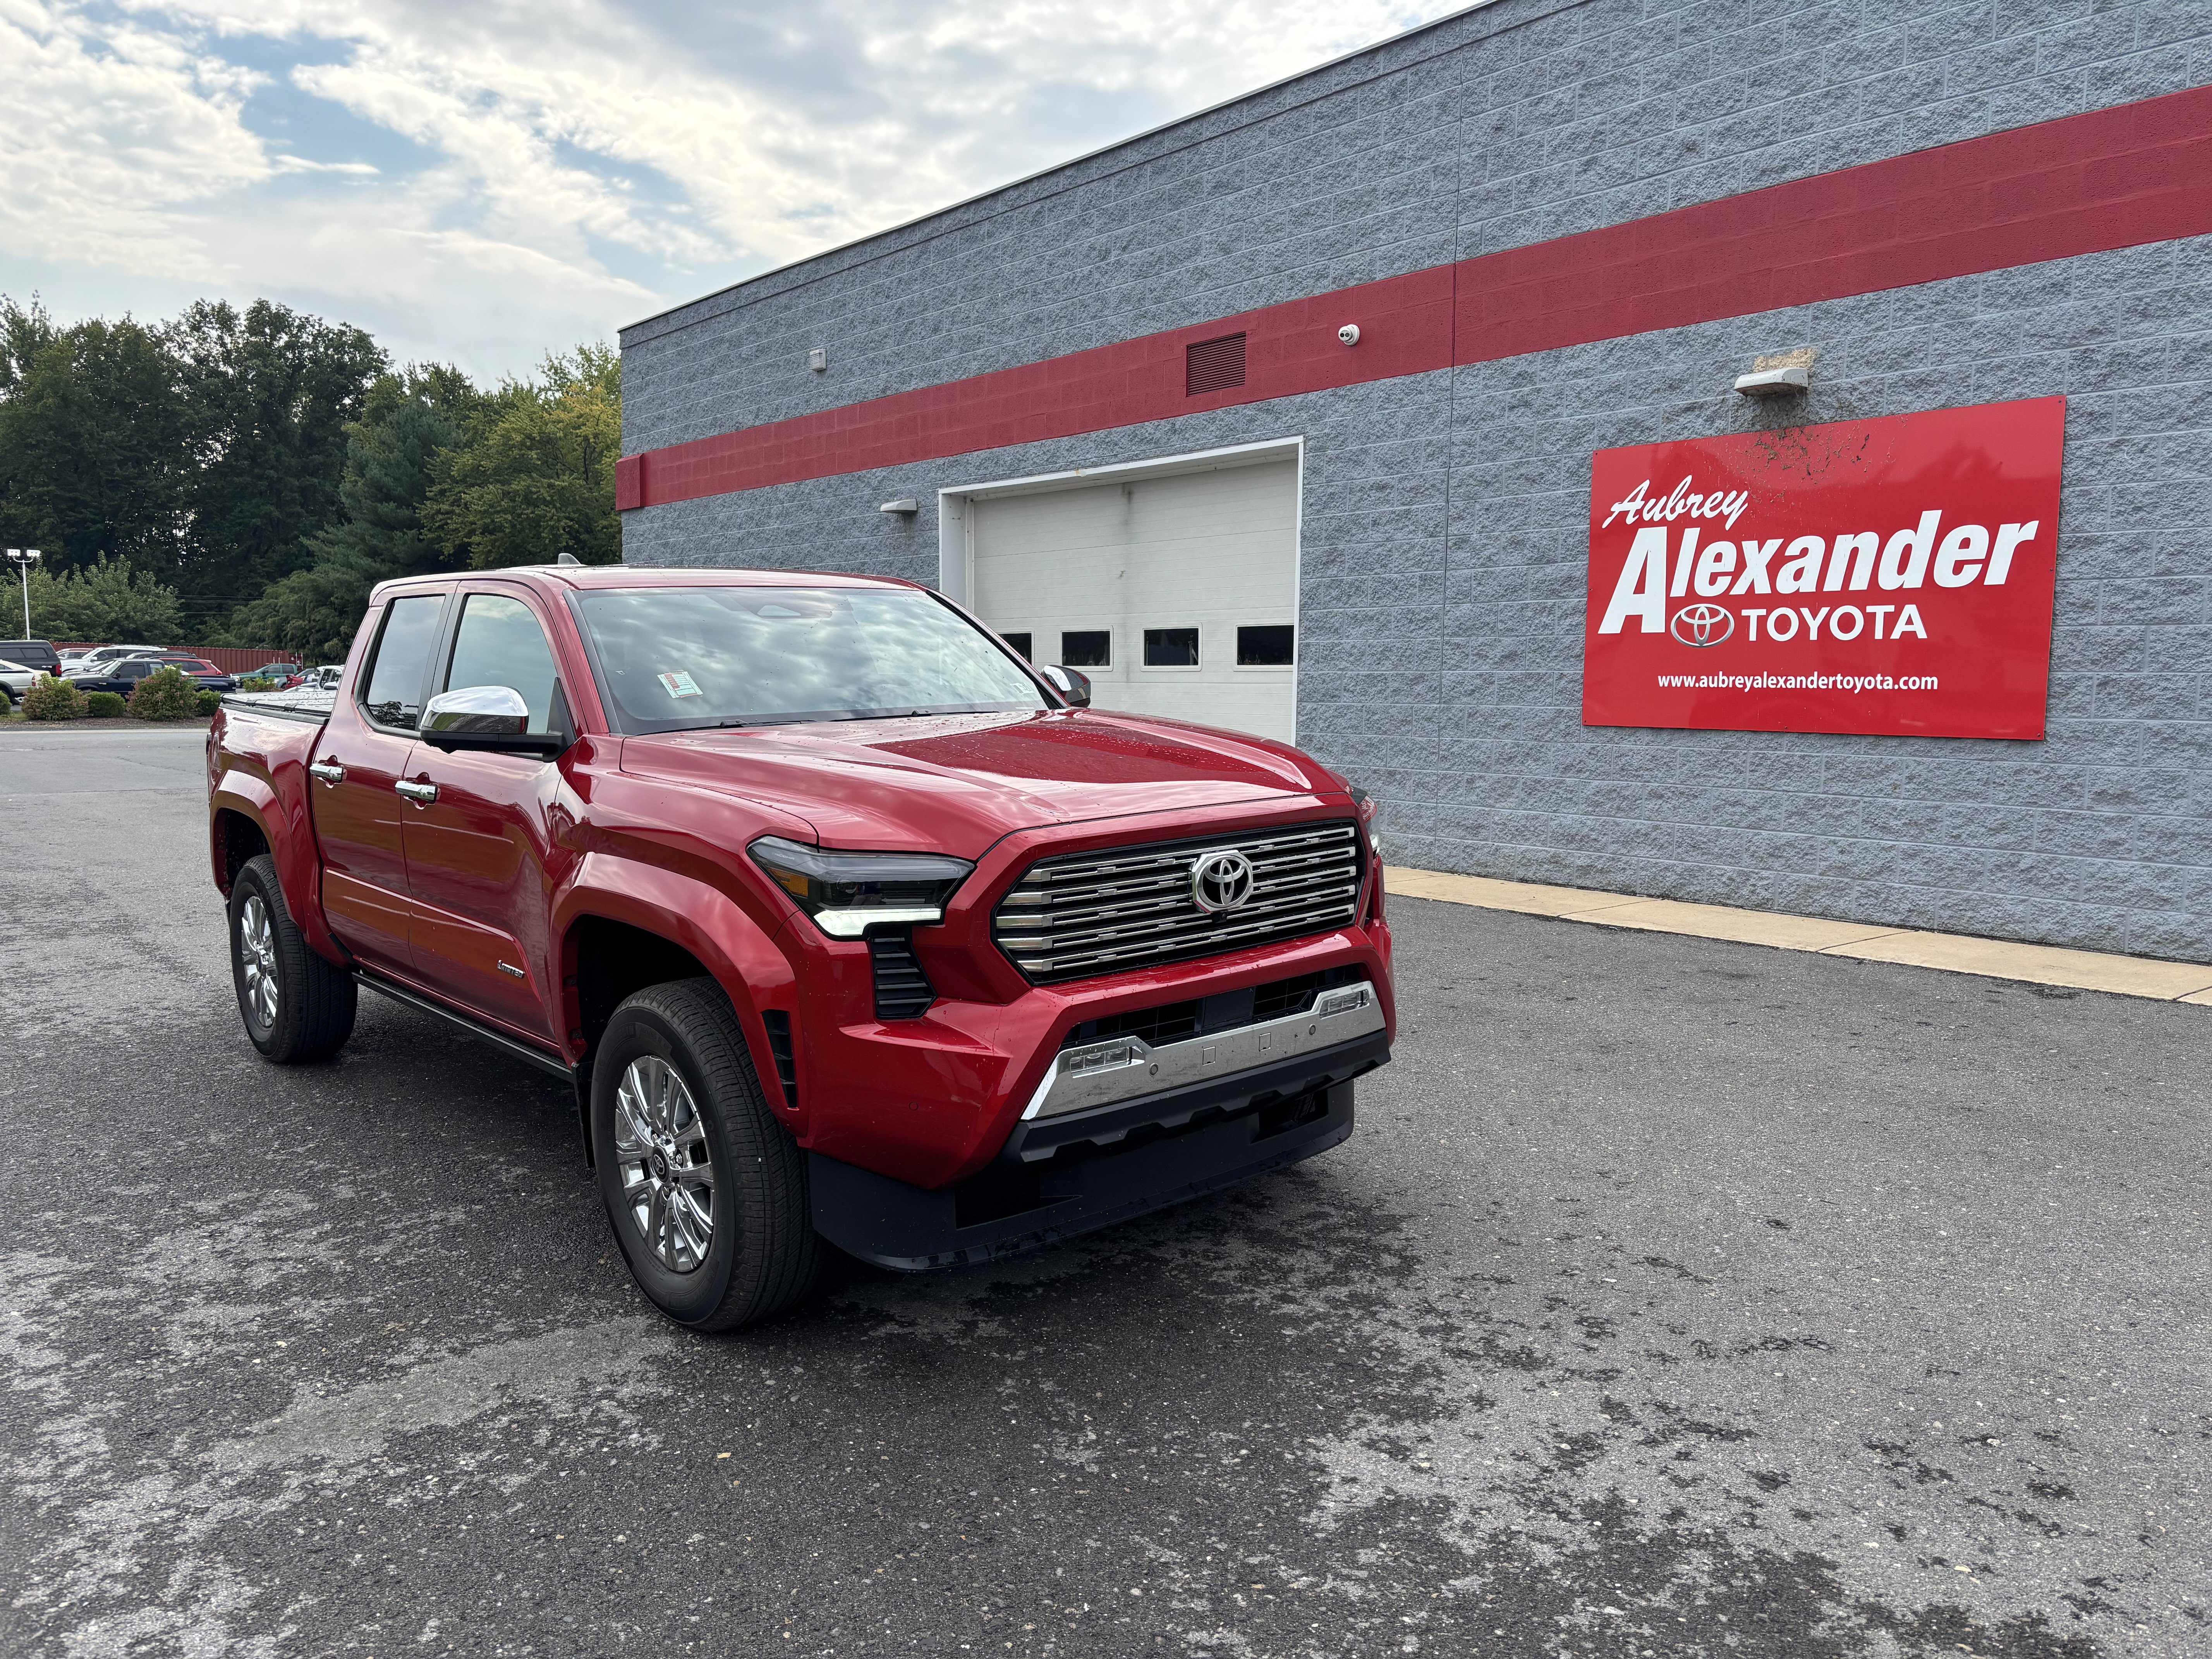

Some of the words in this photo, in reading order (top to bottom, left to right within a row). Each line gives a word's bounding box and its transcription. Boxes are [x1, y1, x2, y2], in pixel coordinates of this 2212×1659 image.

[1602, 475, 1748, 531] Aubrey
[1597, 510, 2039, 634] Alexander
[1741, 604, 1927, 642] TOYOTA
[1658, 671, 1938, 694] www.aubreyalexandertoyota.com
